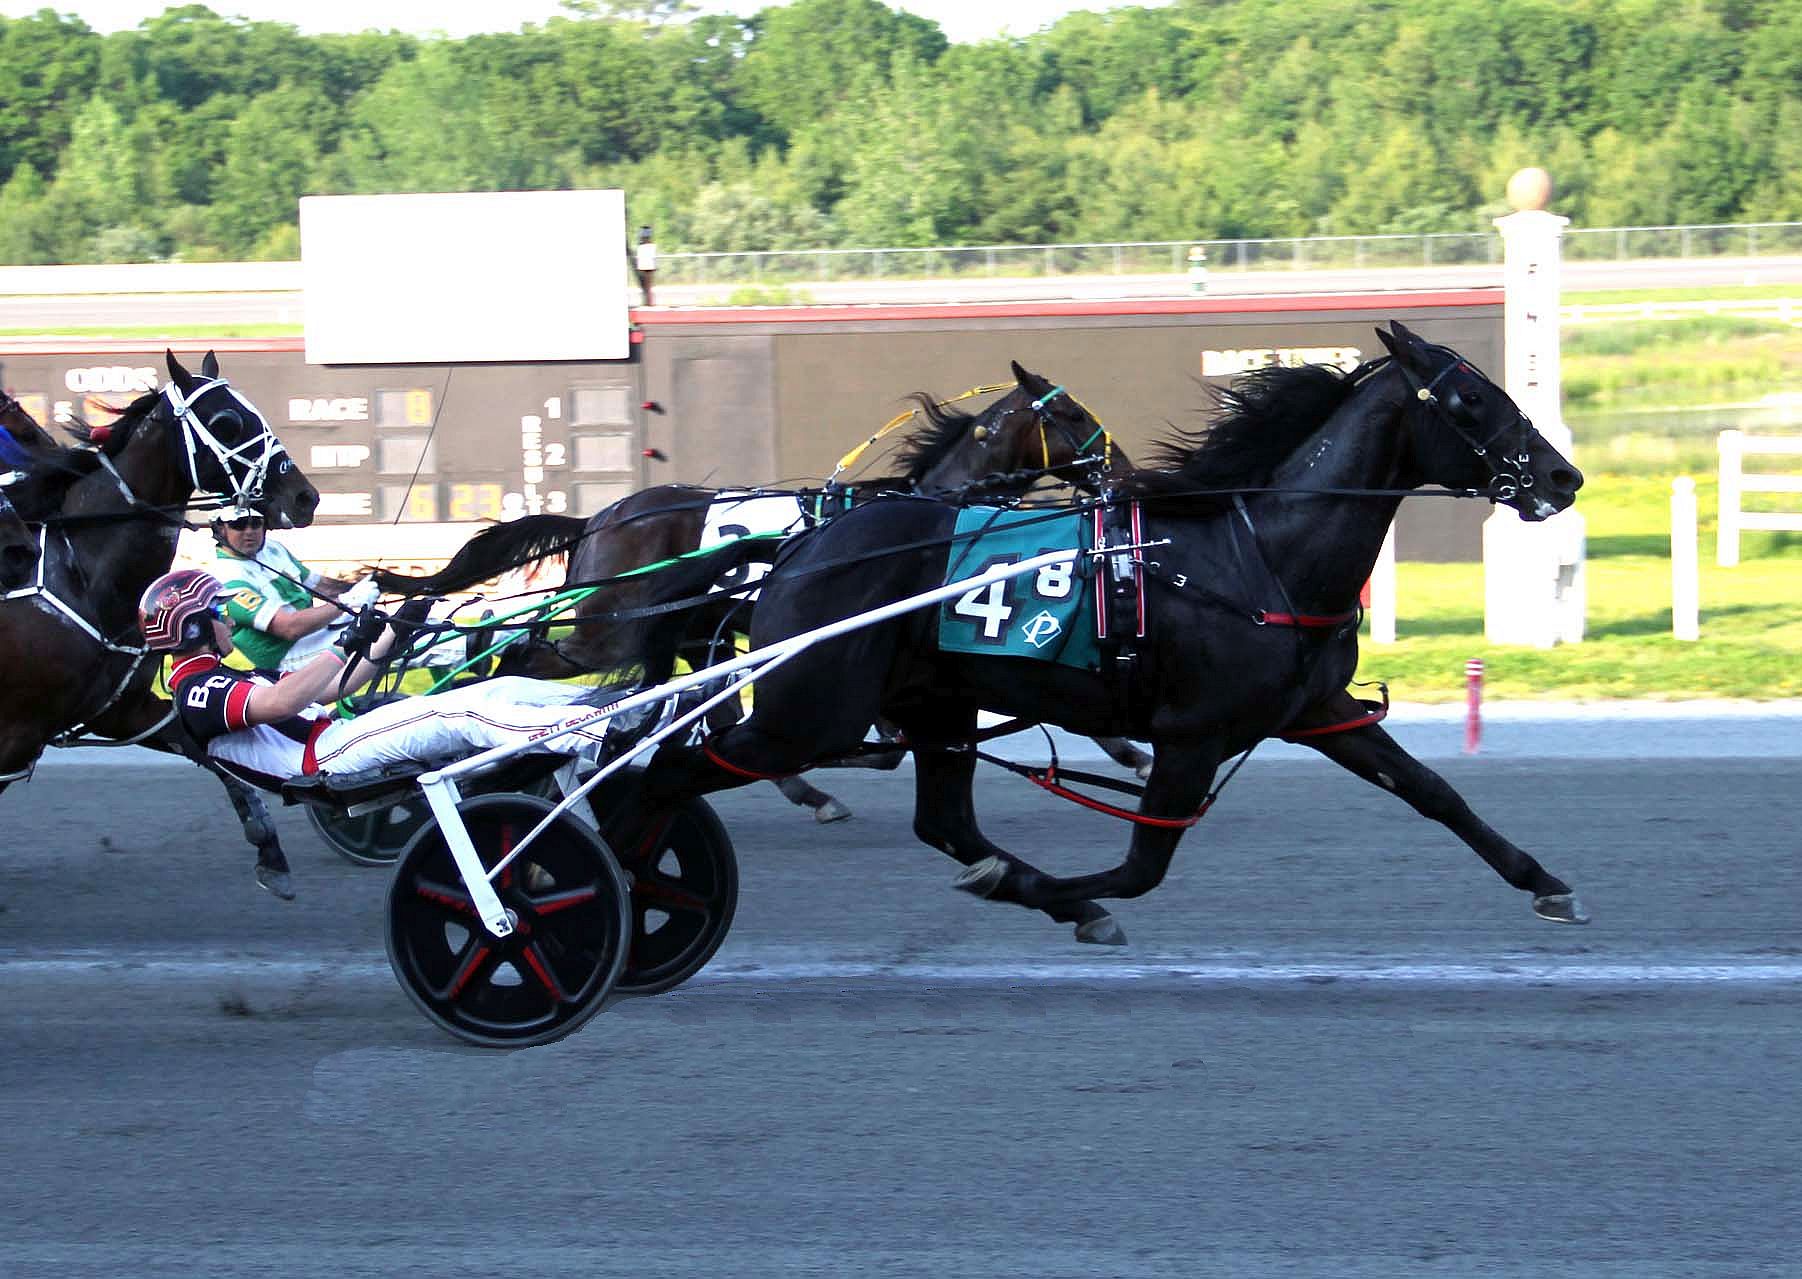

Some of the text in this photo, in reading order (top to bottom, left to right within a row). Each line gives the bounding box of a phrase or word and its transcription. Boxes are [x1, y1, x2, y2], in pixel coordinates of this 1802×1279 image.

[65, 367, 158, 392] ODDS
[288, 399, 369, 420] RACE
[544, 397, 561, 419] 1
[545, 443, 566, 466] 2
[546, 491, 567, 513] 3
[1036, 558, 1074, 598] 8
[955, 562, 1013, 638] 4
